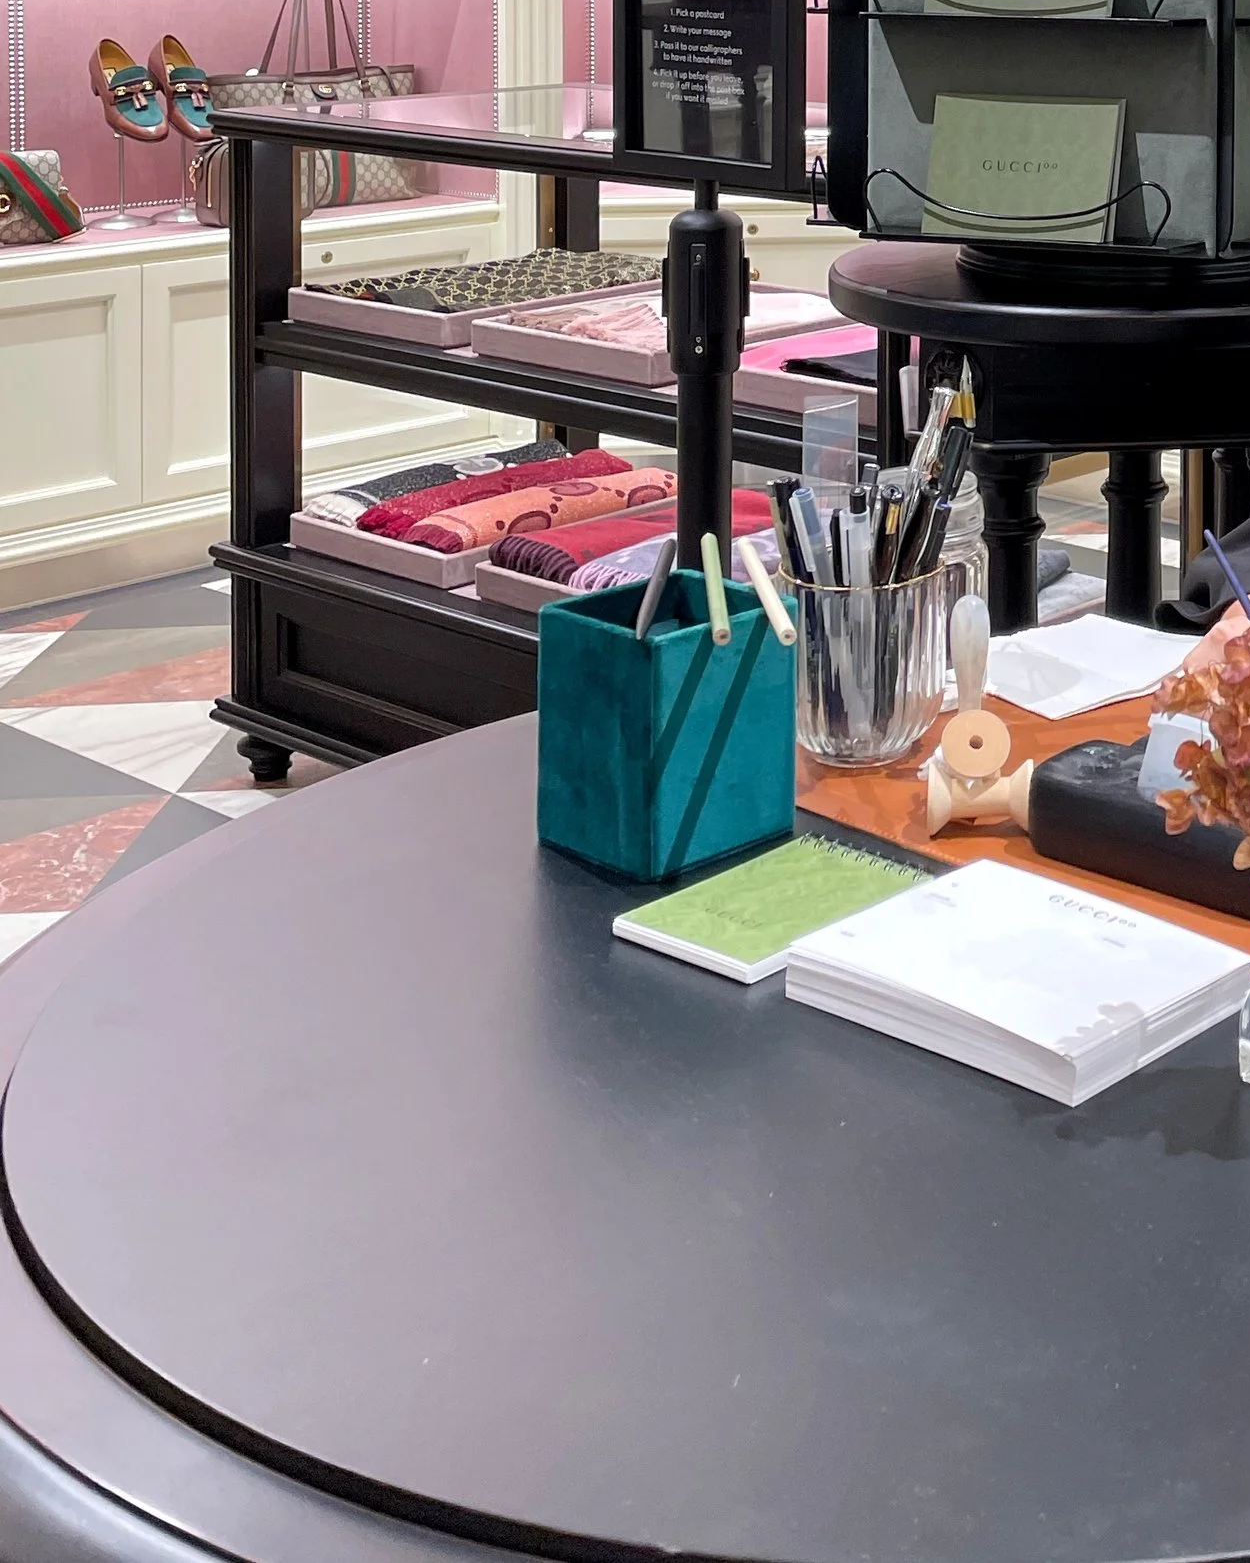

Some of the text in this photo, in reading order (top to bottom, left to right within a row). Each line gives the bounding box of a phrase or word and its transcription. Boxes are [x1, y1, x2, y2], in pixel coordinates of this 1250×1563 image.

[675, 8, 688, 16] Pick
[695, 10, 725, 19] postcard
[670, 25, 687, 34] Write
[688, 27, 702, 35] your
[703, 28, 732, 38] message
[660, 41, 674, 49] Pass
[681, 42, 687, 50] to
[700, 43, 743, 55] calligraphers
[663, 52, 670, 60] to
[671, 53, 686, 62] have
[693, 54, 733, 65] handwritten
[689, 71, 709, 80] before
